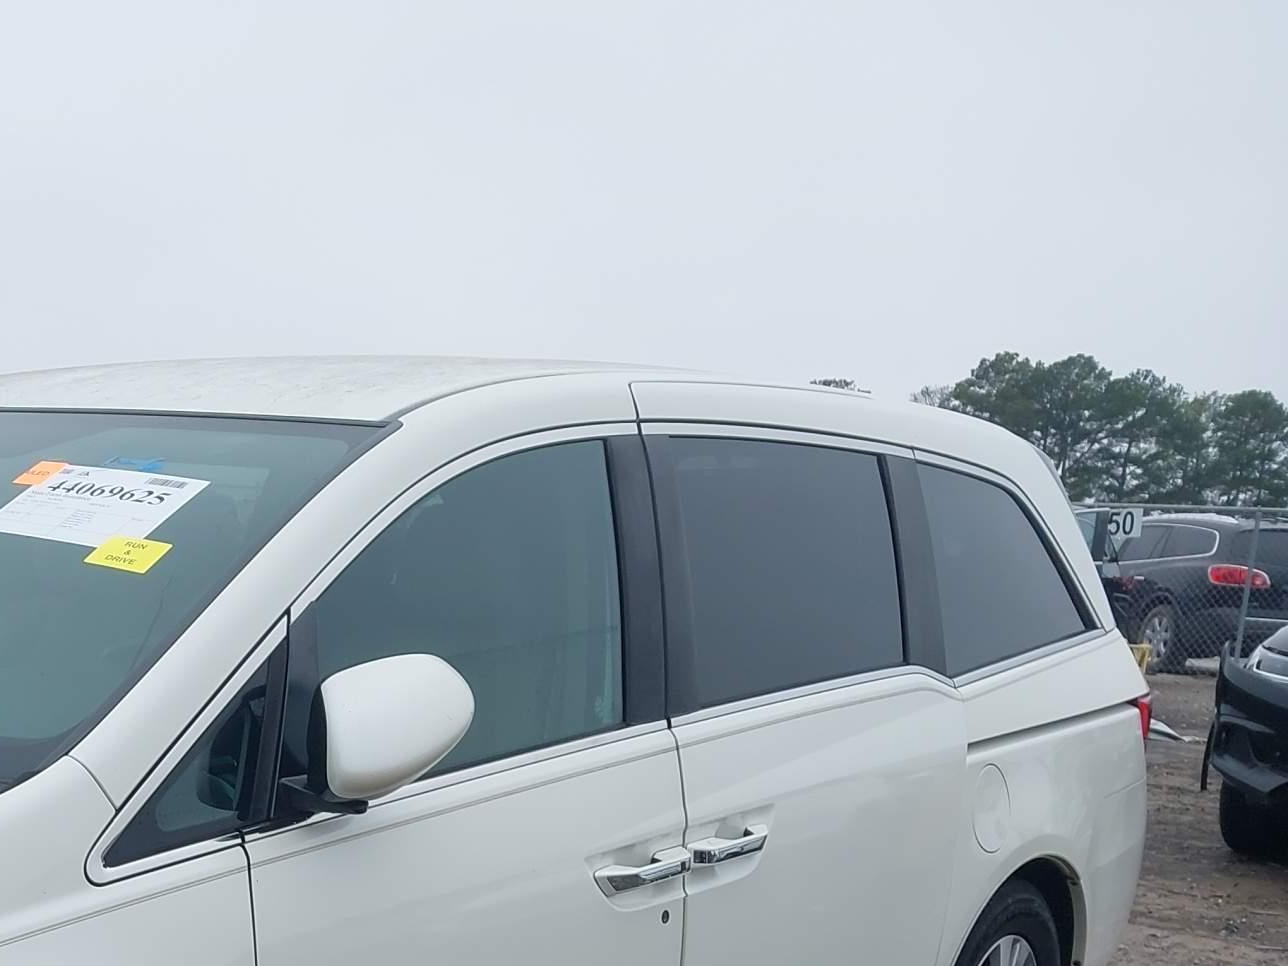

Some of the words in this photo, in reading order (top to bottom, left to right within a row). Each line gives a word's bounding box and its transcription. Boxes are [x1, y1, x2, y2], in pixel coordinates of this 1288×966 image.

[48, 480, 172, 506] 44069625
[1108, 511, 1135, 535] 50
[124, 541, 148, 550] RUN
[104, 554, 137, 565] DRIVE
